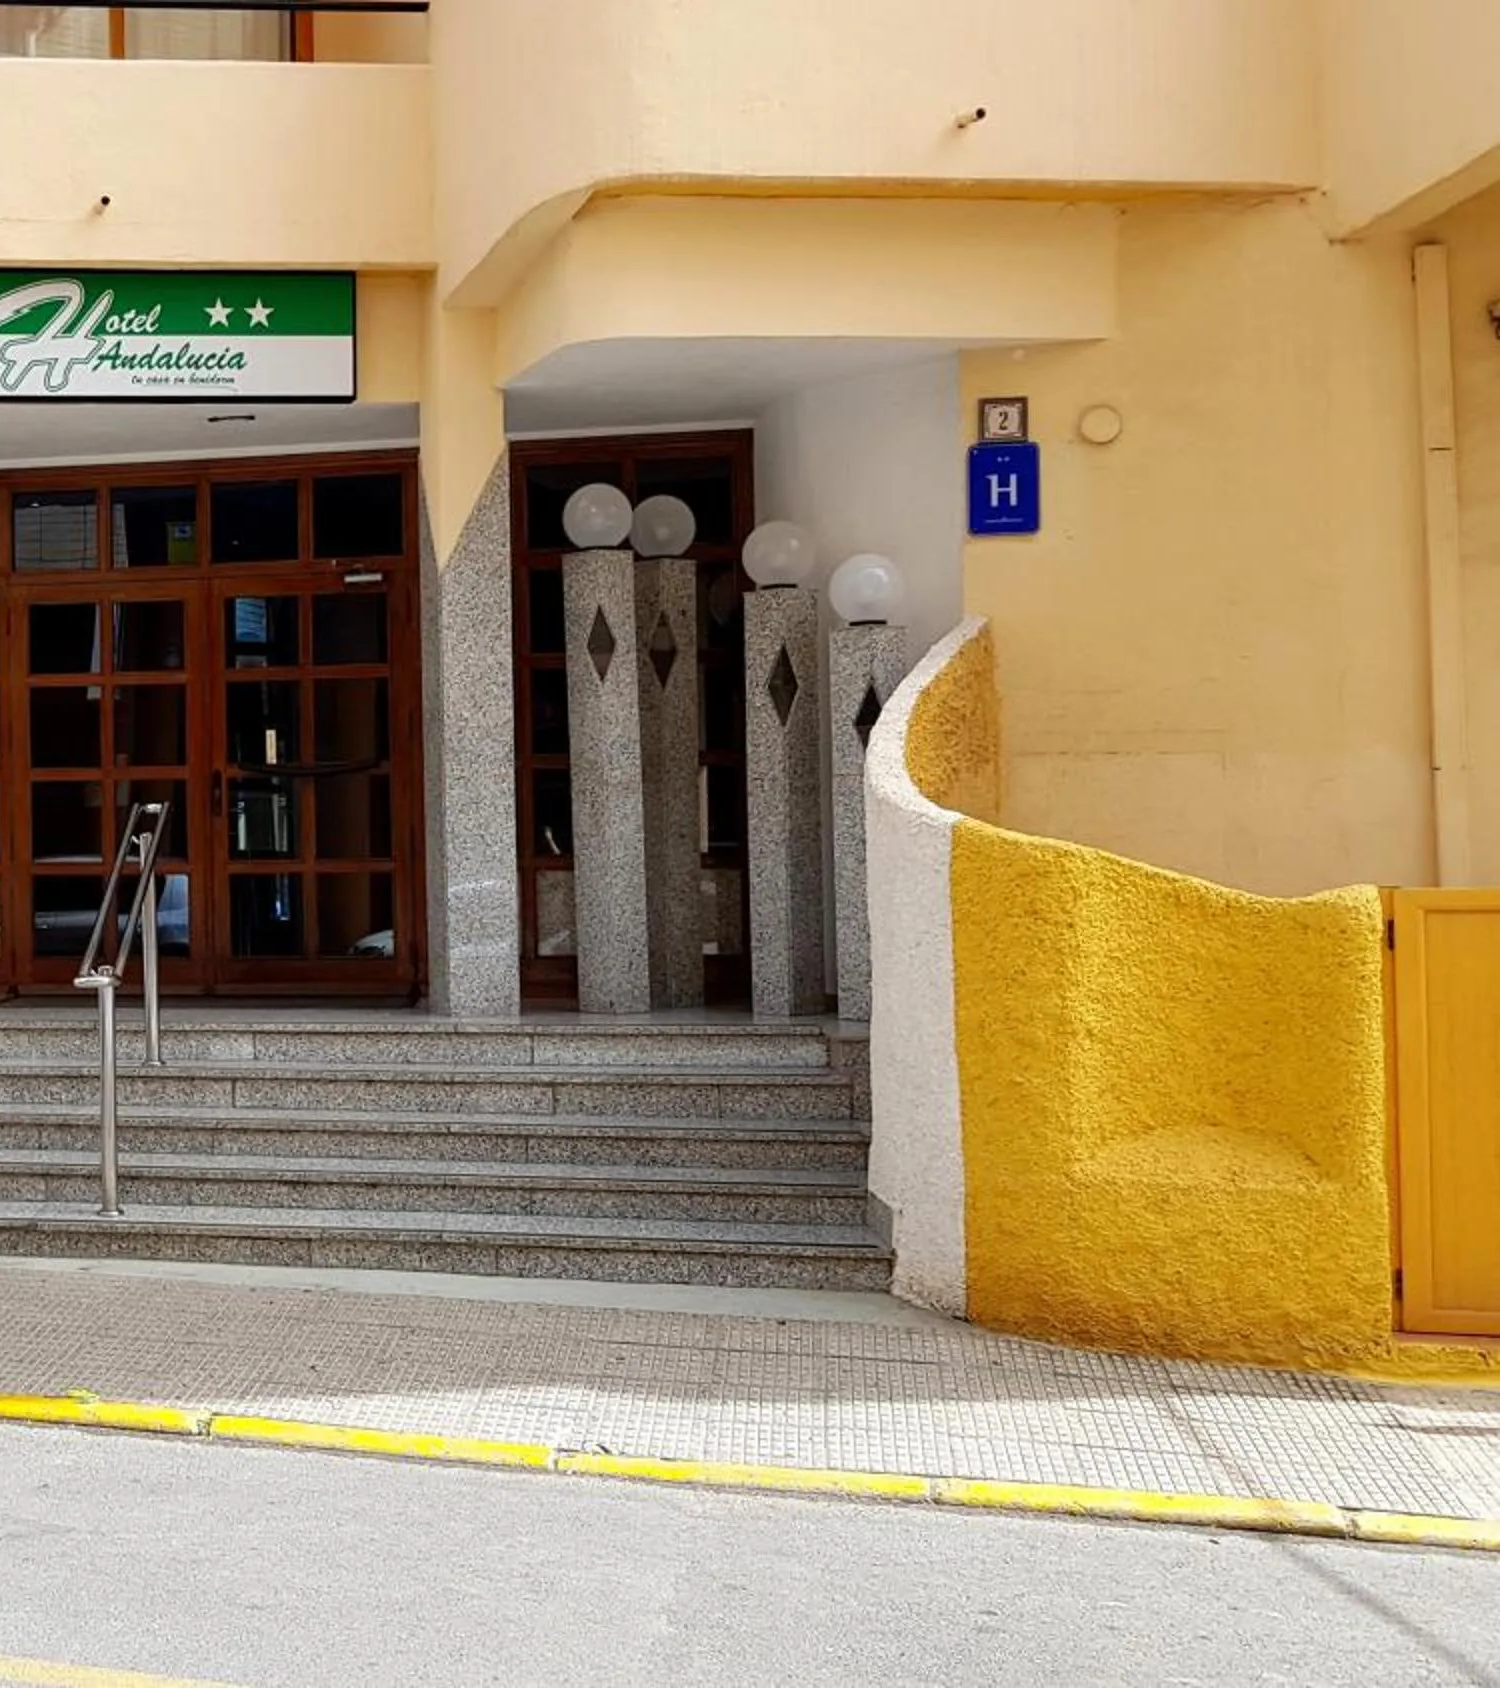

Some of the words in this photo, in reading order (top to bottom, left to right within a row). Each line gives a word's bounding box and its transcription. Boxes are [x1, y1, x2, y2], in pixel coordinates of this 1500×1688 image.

[92, 340, 247, 372] Andalucia
[998, 410, 1009, 431] 2
[985, 473, 1018, 507] H
